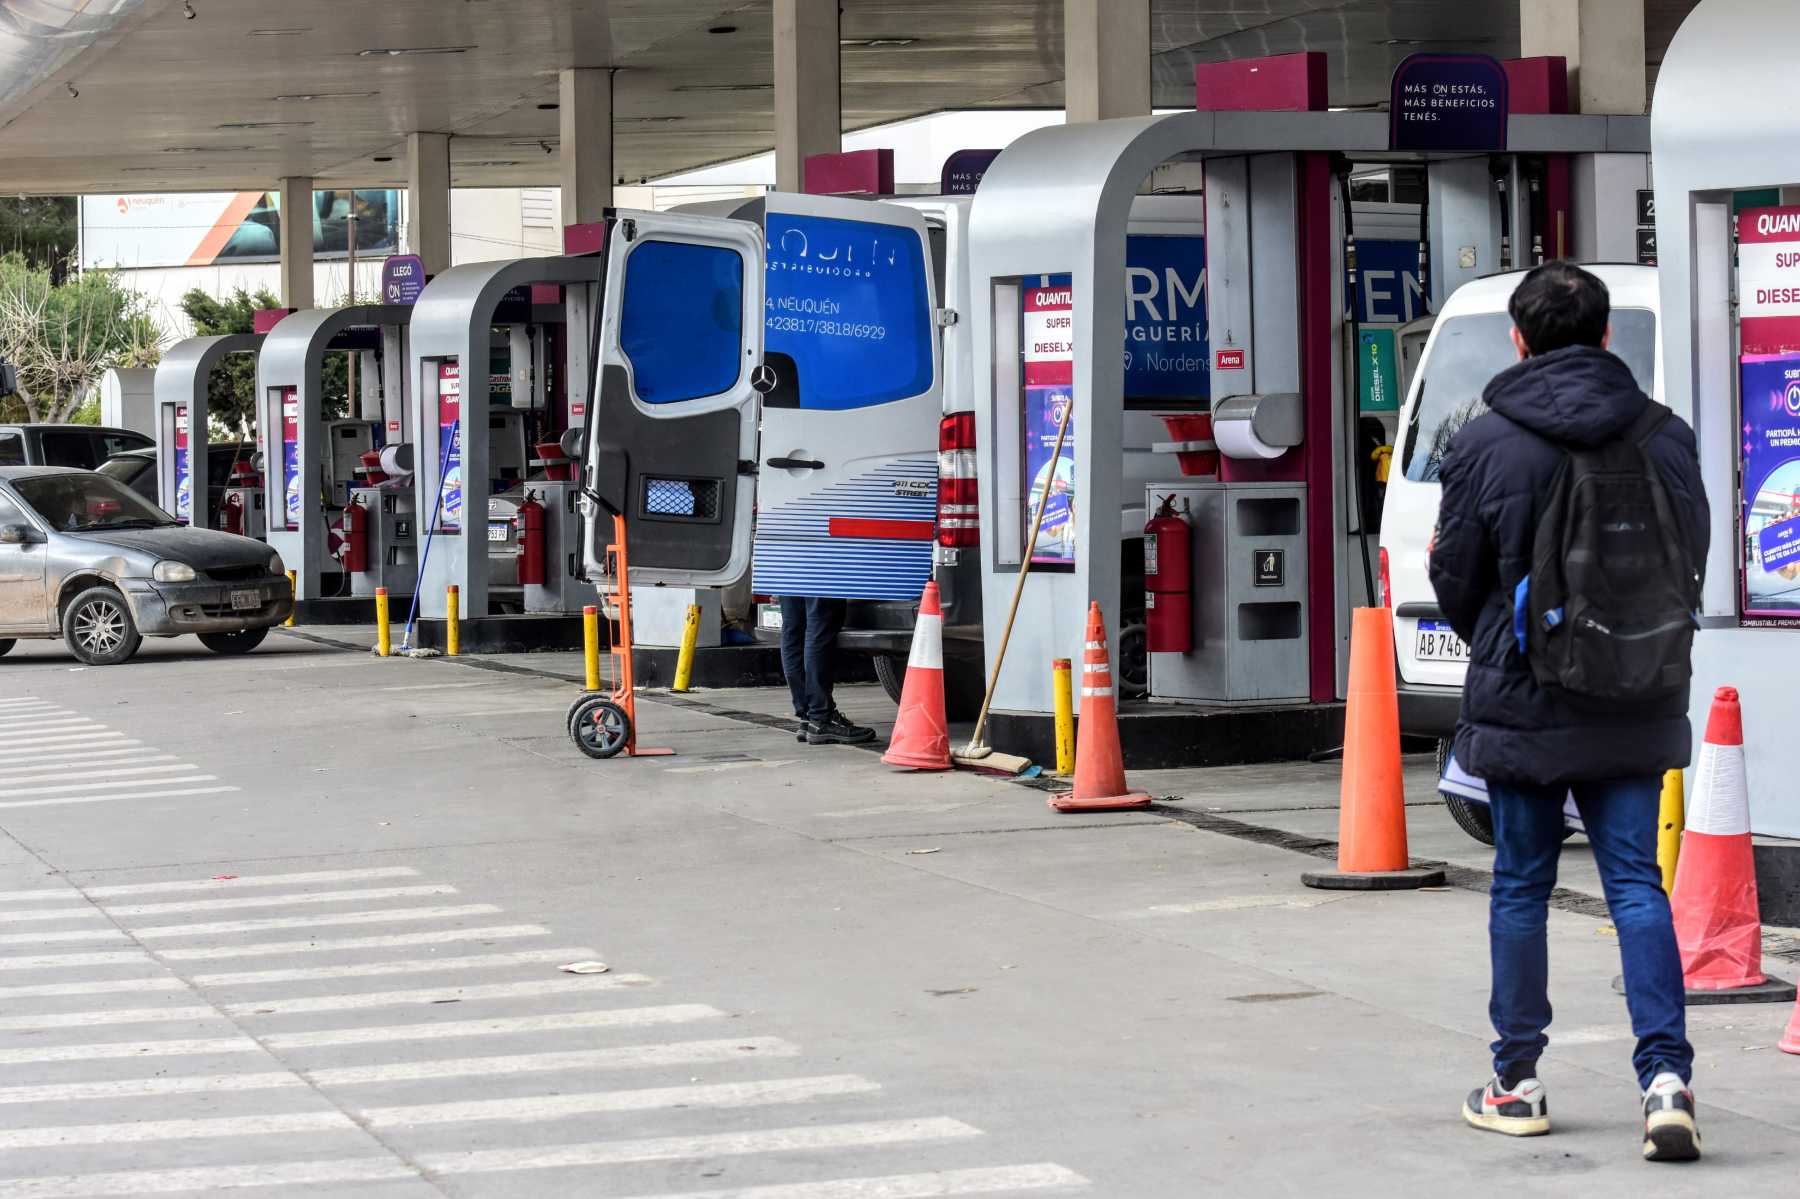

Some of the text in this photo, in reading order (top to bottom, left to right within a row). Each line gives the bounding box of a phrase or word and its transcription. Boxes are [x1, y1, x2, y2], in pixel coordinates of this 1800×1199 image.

[1404, 83, 1427, 94] MÁS
[1451, 84, 1486, 95] ESTÁS,
[1404, 98, 1495, 108] MÁS BENEFICIOS
[1404, 112, 1441, 121] TENÉS.
[393, 264, 412, 277] LLEGÓ
[778, 297, 840, 315] NEUQUÉN
[1046, 317, 1071, 329] SUPER
[1034, 342, 1066, 353] DIESEL
[1220, 355, 1240, 365] Arena
[1419, 633, 1435, 655] AB
[1439, 634, 1461, 656] 746
